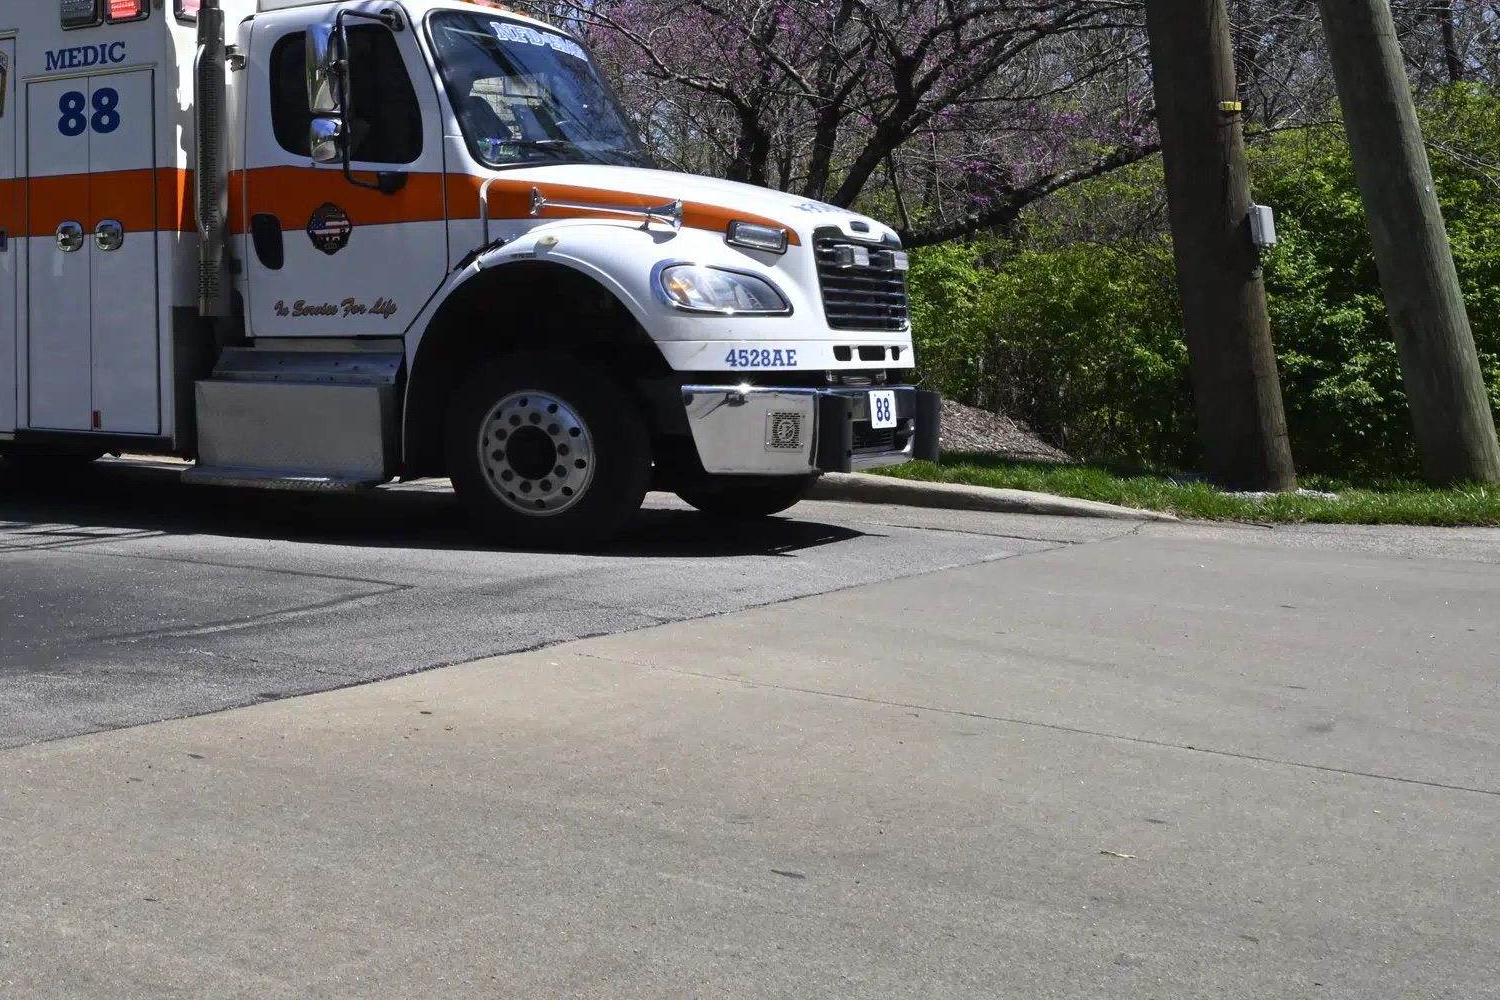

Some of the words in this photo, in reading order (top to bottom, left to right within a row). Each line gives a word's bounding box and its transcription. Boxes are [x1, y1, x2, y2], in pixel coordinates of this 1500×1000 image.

[45, 41, 126, 71] MEDIC
[58, 87, 121, 137] 88
[274, 300, 289, 316] In
[291, 299, 339, 317] Service
[340, 297, 367, 318] For
[367, 296, 398, 319] Life
[725, 348, 798, 367] 4528AE
[876, 397, 891, 422] 88
